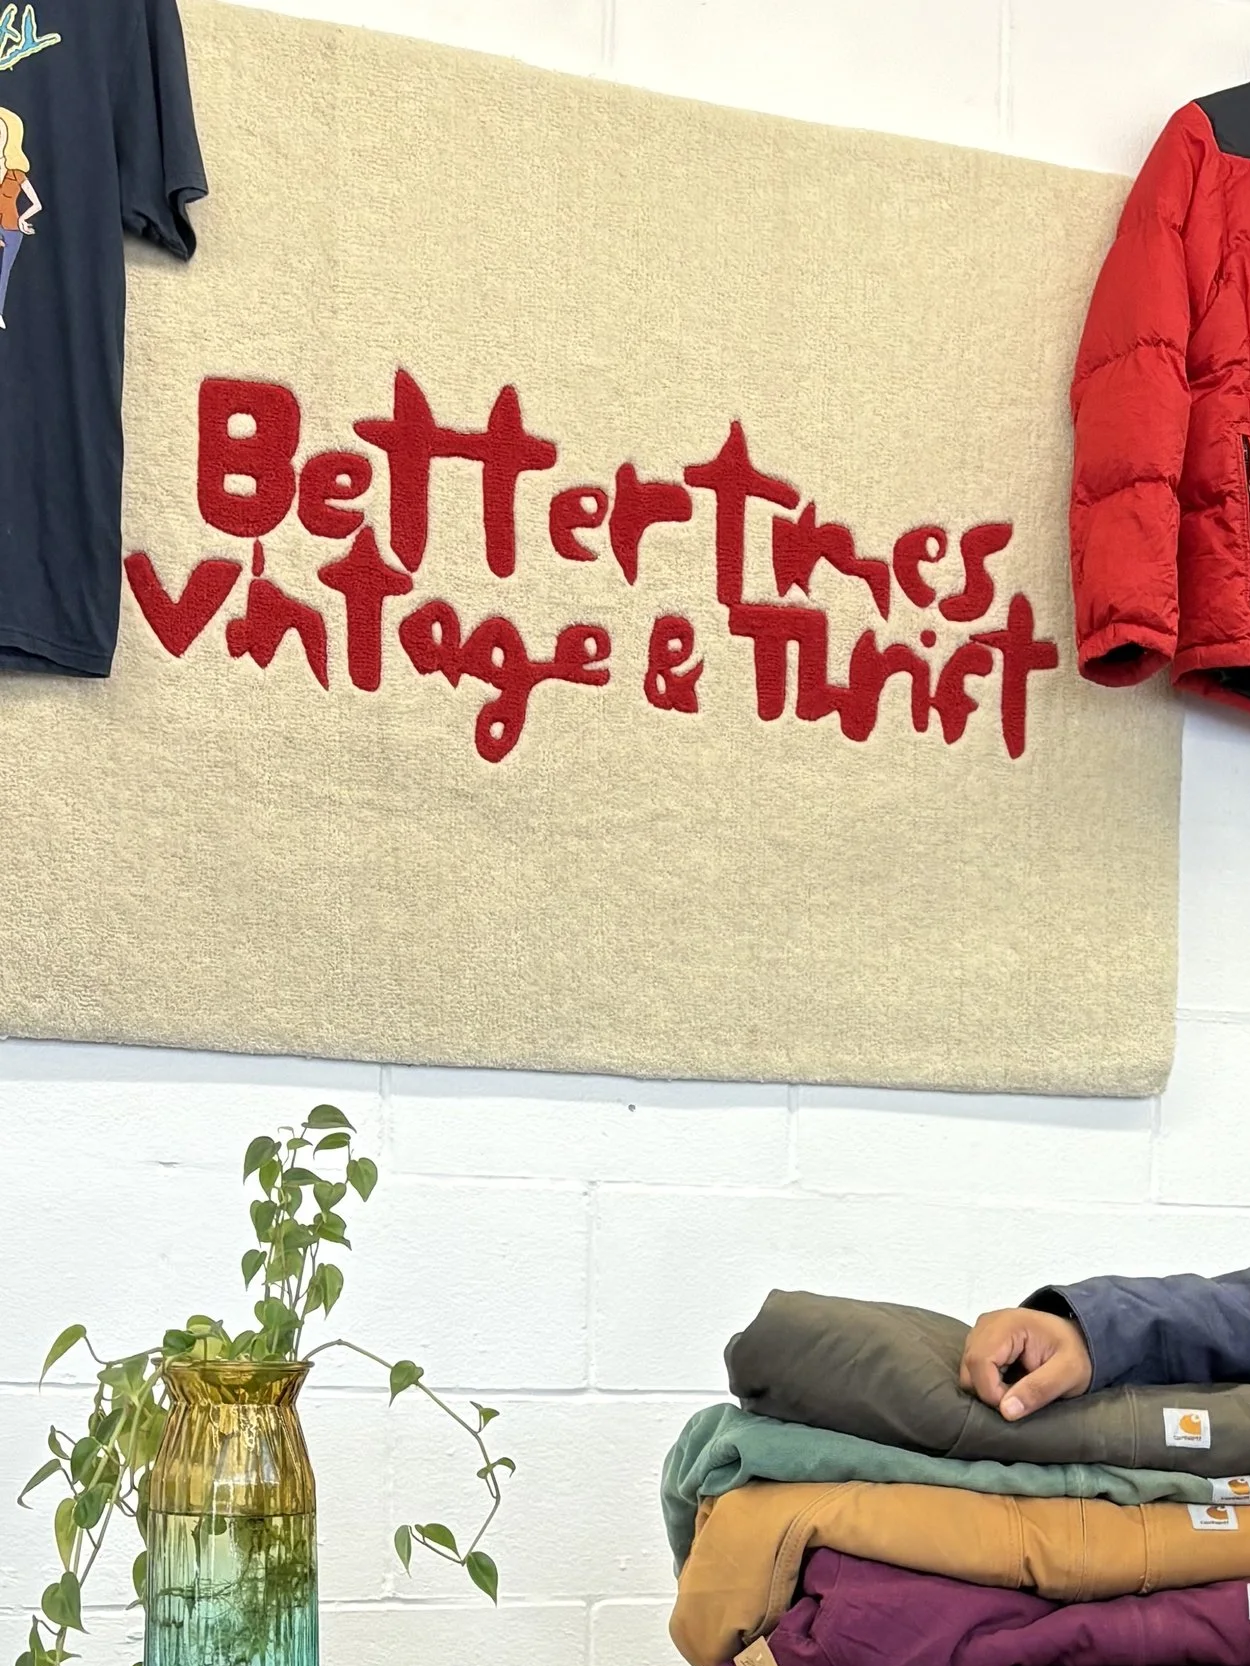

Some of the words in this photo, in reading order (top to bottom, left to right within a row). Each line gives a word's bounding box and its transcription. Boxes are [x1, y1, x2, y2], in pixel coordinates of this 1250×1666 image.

[196, 368, 693, 586] Better
[683, 419, 1014, 622] Times
[643, 614, 704, 714] &
[728, 593, 1059, 760] Thrift
